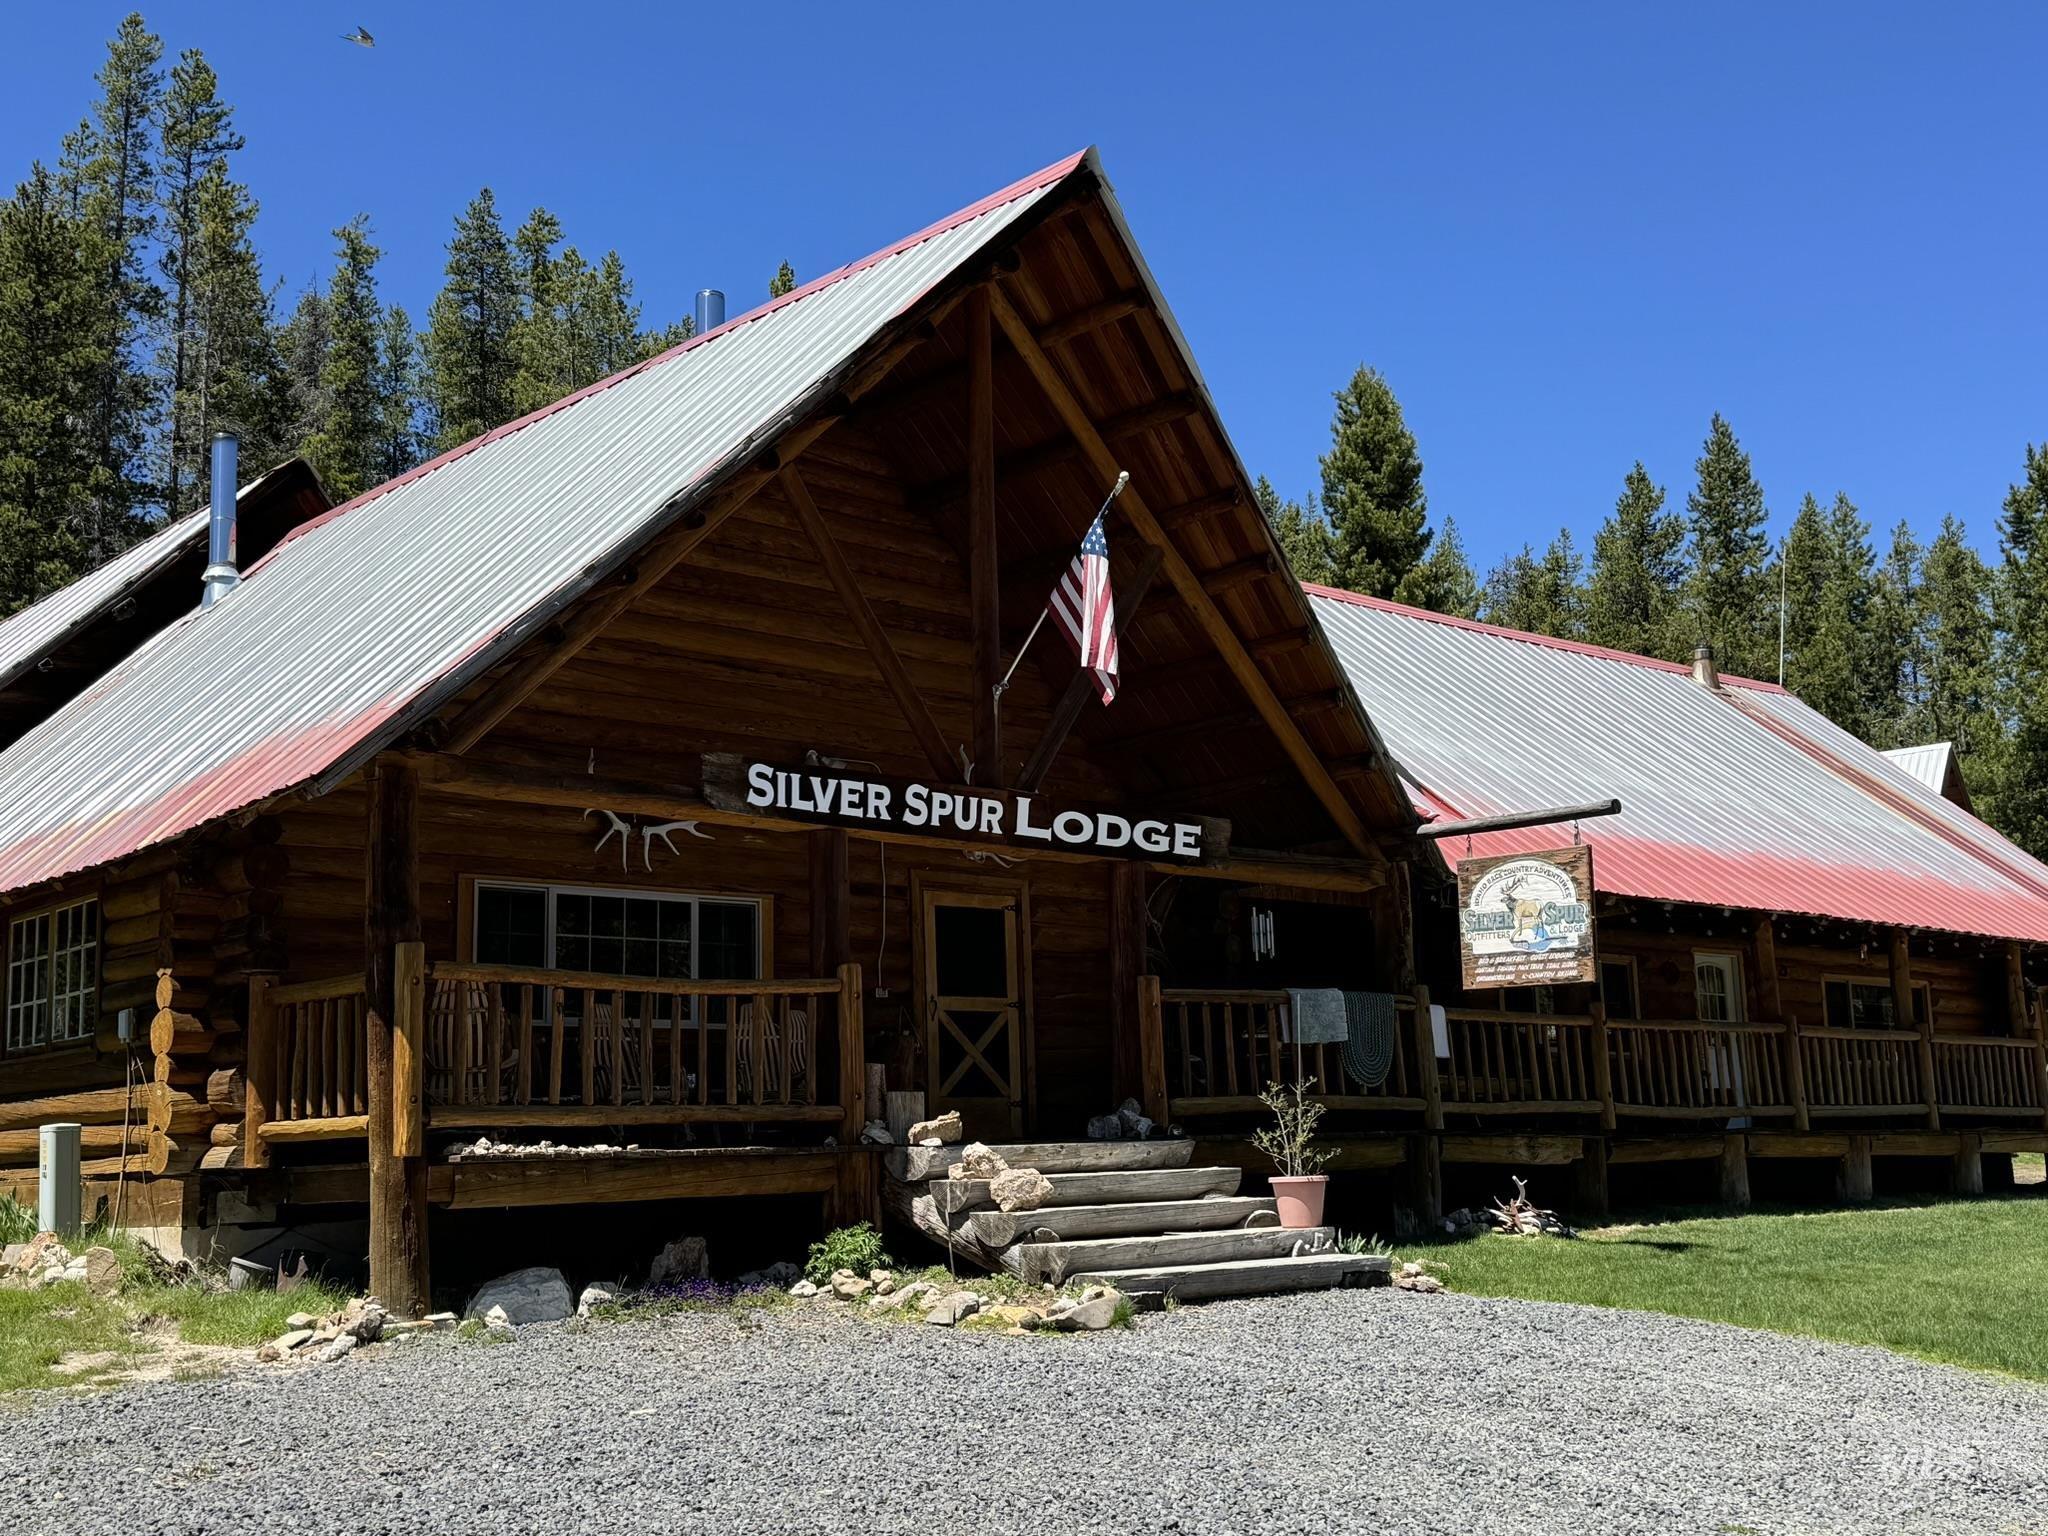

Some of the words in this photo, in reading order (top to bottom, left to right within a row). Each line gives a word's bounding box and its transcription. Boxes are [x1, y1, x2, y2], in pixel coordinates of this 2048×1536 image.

[747, 764, 891, 820] SILVER
[903, 784, 1003, 834] SPUR
[1015, 797, 1201, 857] LODGE
[1474, 882, 1488, 907] IDAHO
[1503, 865, 1533, 876] COUNTRY
[1534, 866, 1572, 898] ADVENTURES
[1464, 909, 1515, 932] SILVER
[1544, 902, 1585, 925] SPUR
[1466, 930, 1511, 941] OUTFITTERS
[1549, 925, 1558, 935] &
[1559, 923, 1584, 934] LODGE
